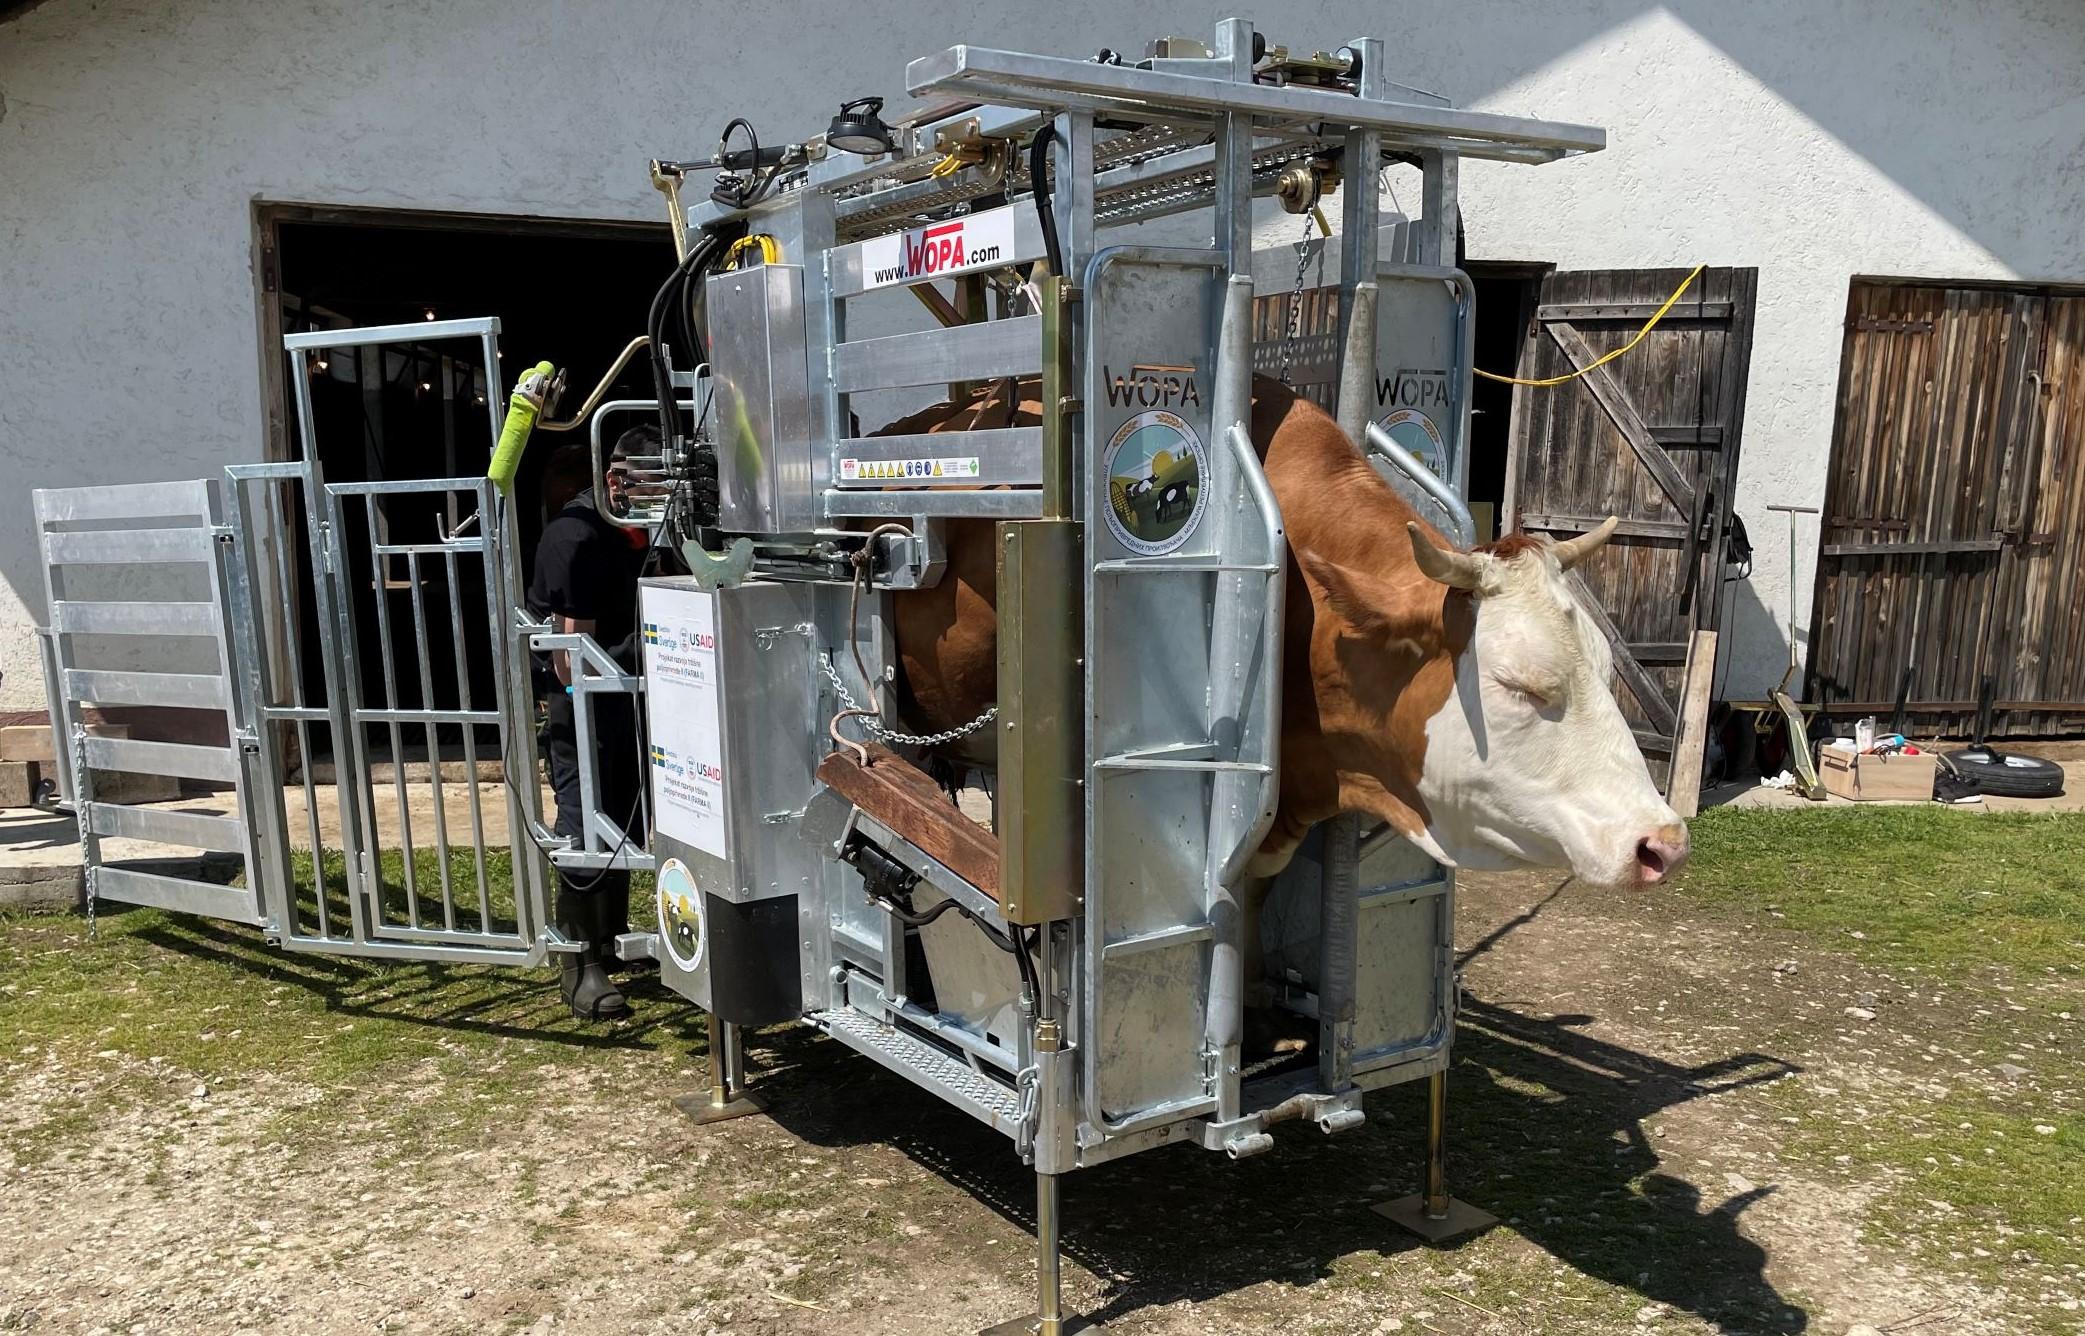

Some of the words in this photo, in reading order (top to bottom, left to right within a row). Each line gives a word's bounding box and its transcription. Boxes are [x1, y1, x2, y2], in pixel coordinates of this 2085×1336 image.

[1104, 363, 1200, 408] WOPA
[1376, 367, 1449, 407] WOPA
[689, 633, 714, 649] USAID
[696, 762, 721, 781] USAID
